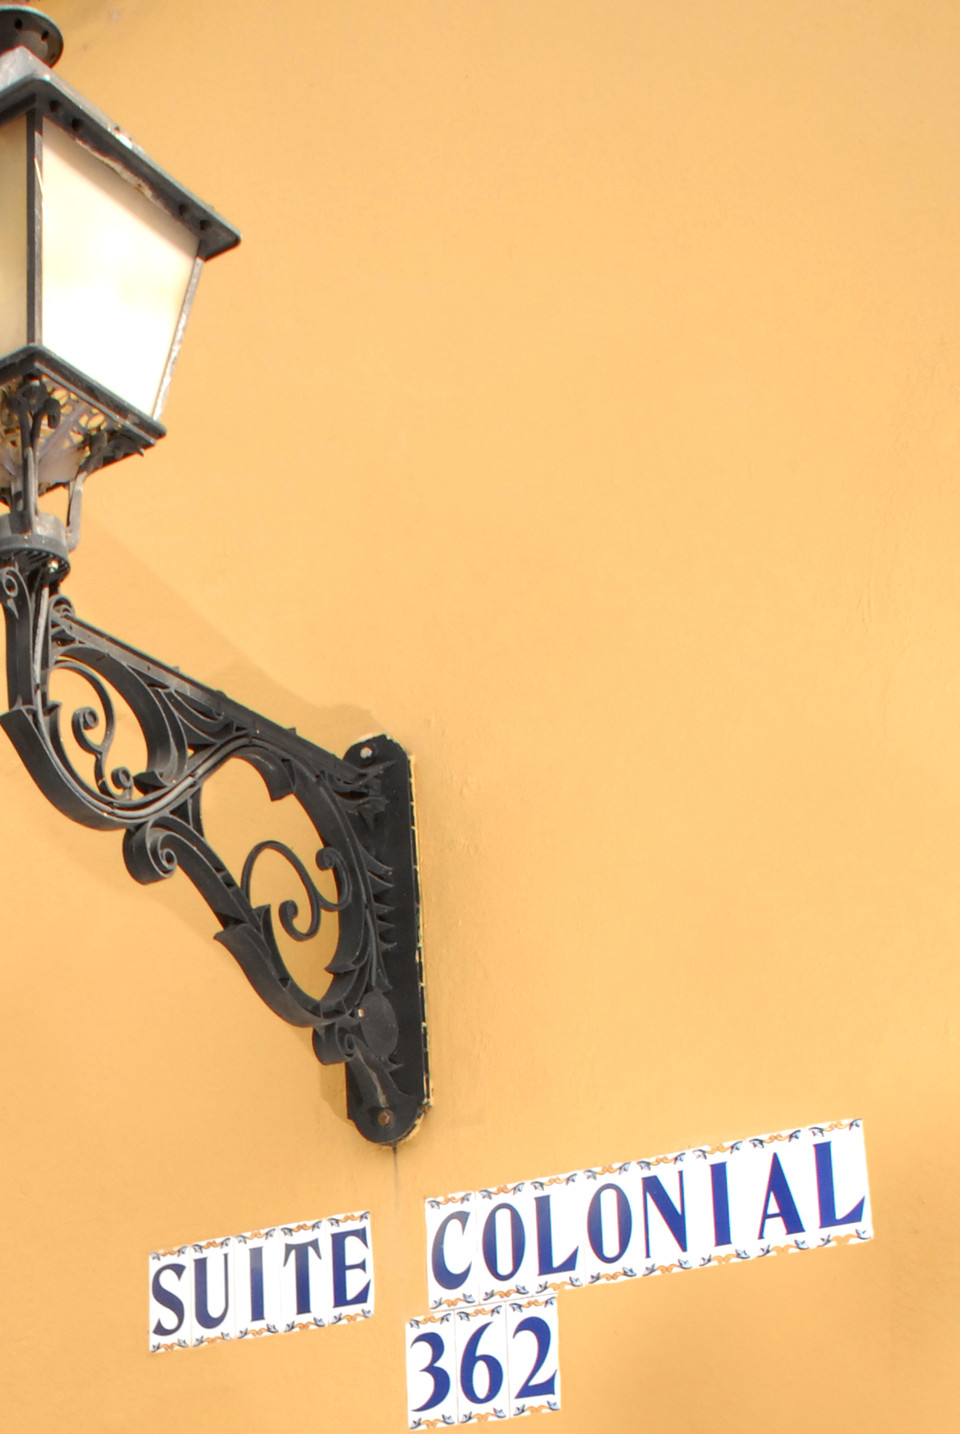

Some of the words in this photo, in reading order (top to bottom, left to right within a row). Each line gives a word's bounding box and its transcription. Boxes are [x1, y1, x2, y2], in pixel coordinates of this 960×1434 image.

[151, 1227, 372, 1337] SUITE
[431, 1141, 867, 1290] COLONIAL
[409, 1316, 558, 1413] 362
